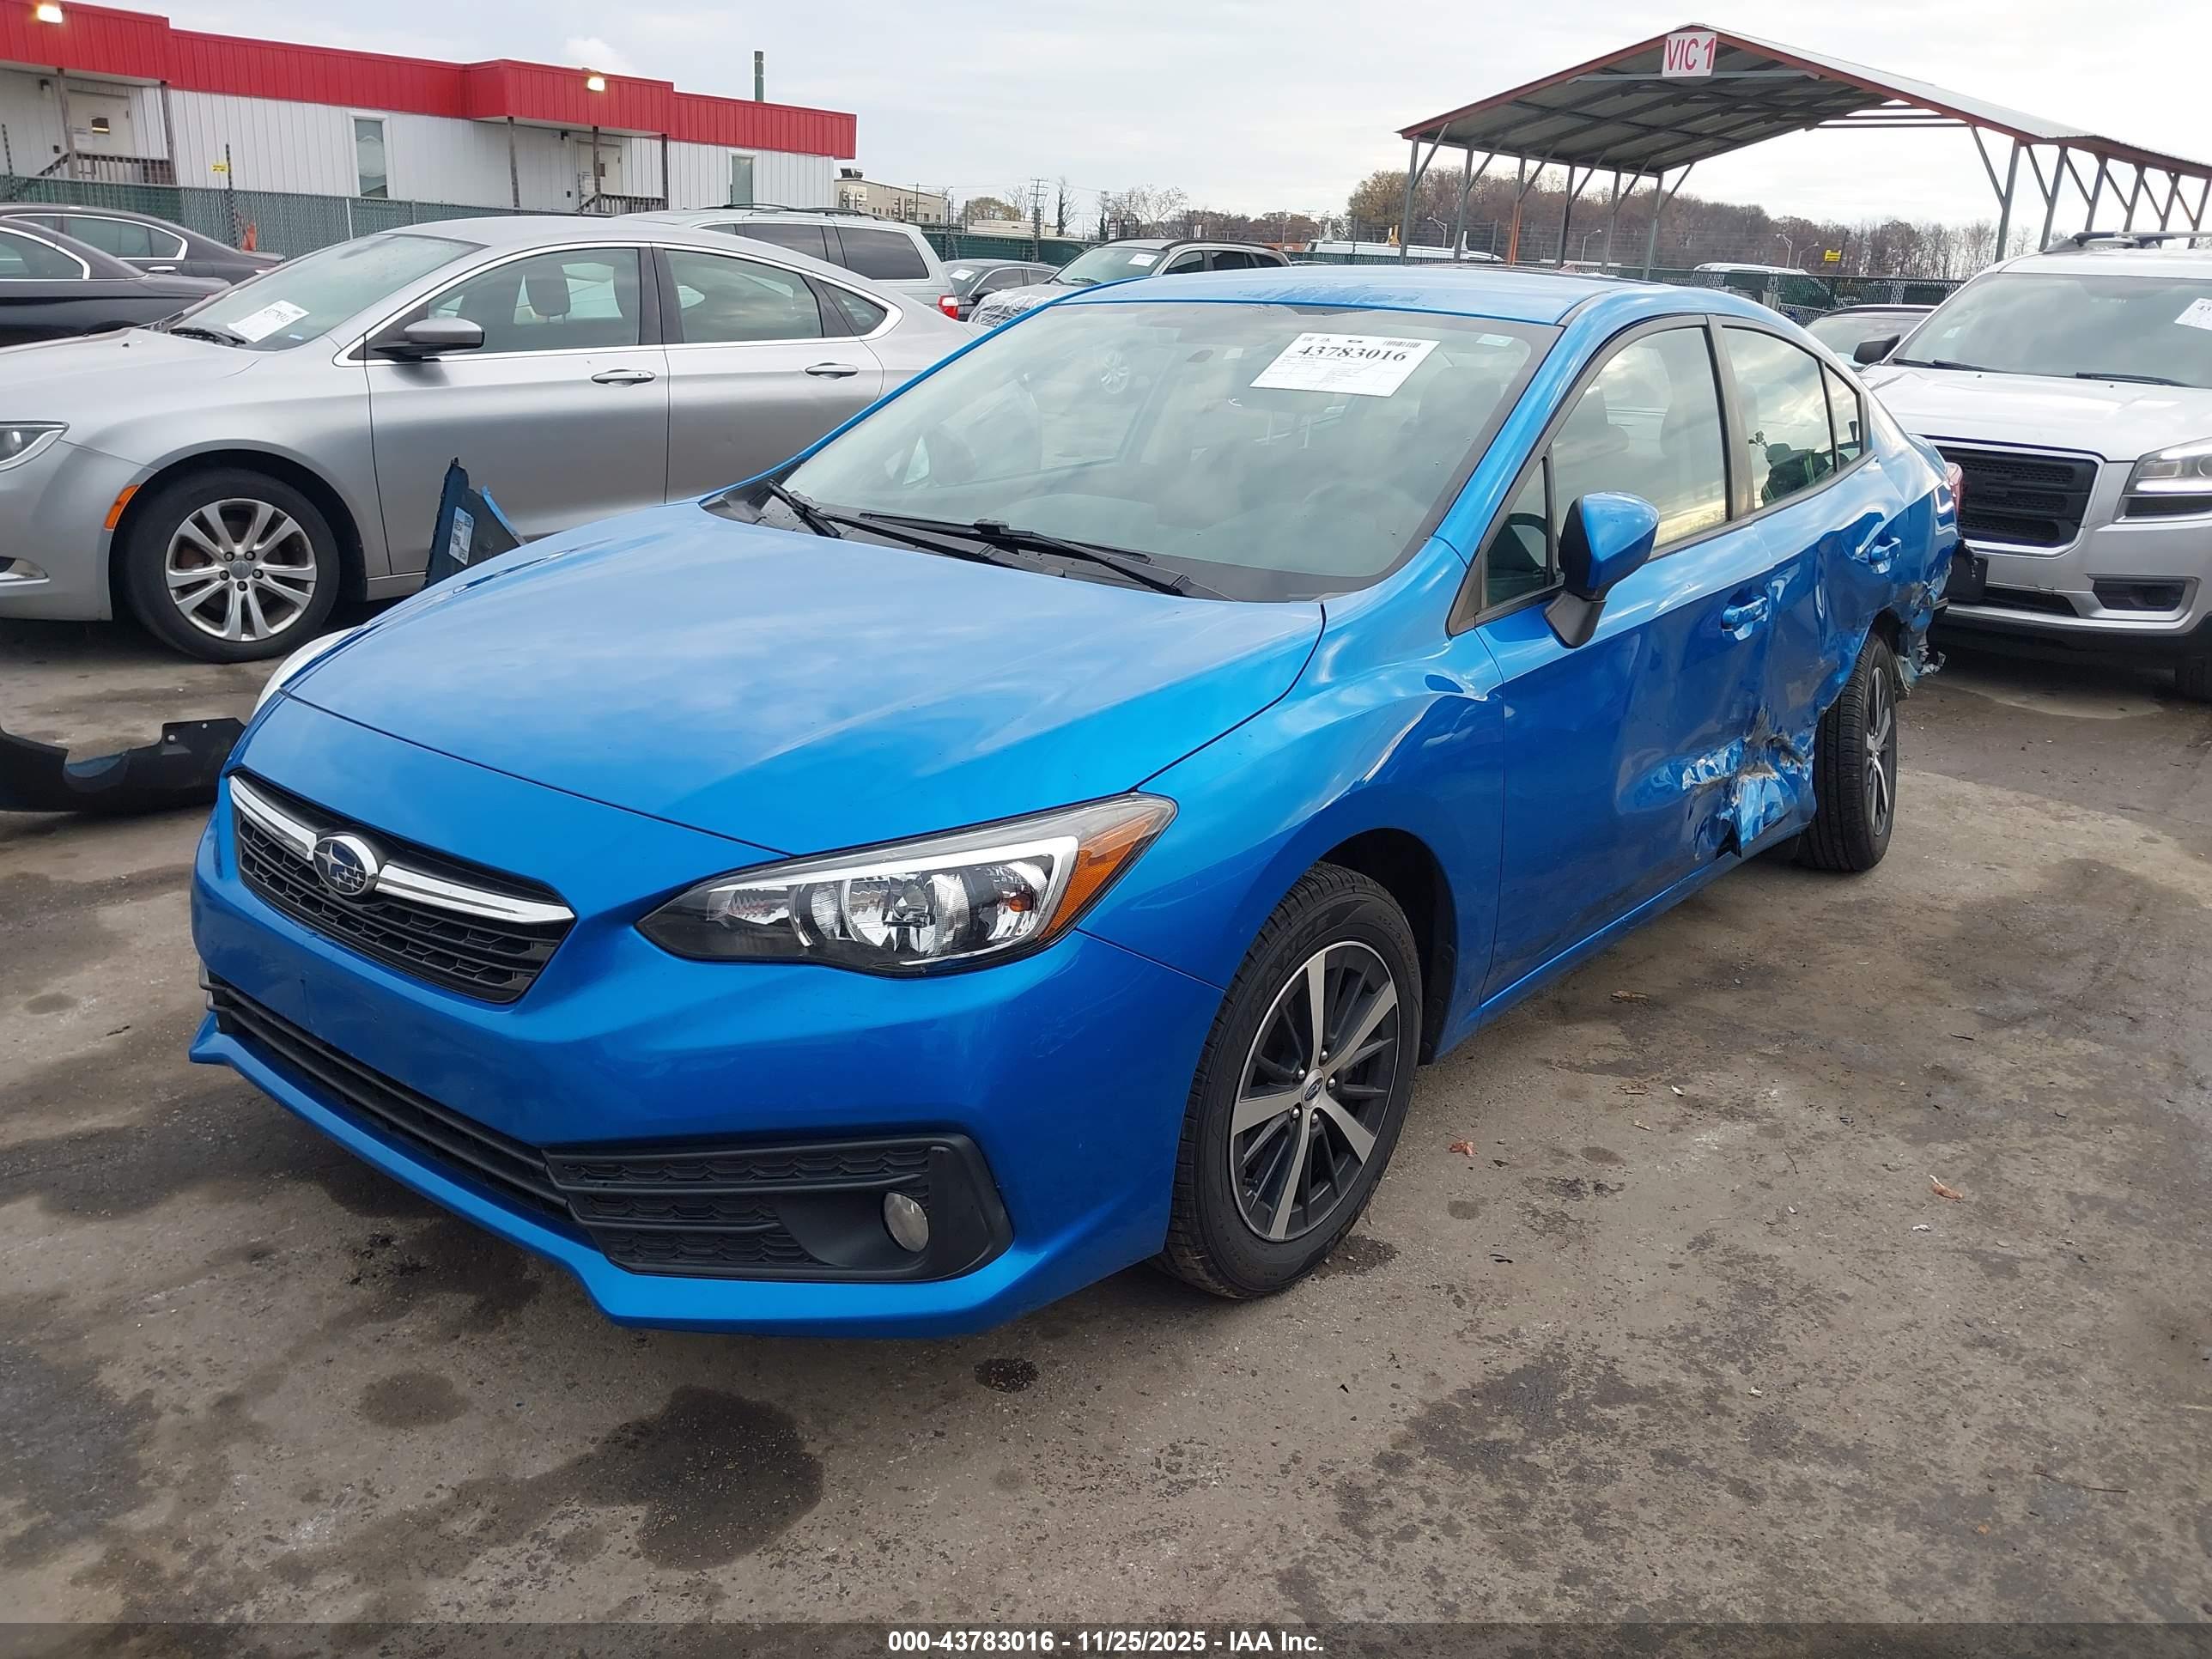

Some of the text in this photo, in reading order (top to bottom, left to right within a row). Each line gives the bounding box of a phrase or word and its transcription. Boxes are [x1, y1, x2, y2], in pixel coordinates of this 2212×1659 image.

[1668, 37, 1715, 70] VIC 1
[1297, 346, 1407, 362] 43783016
